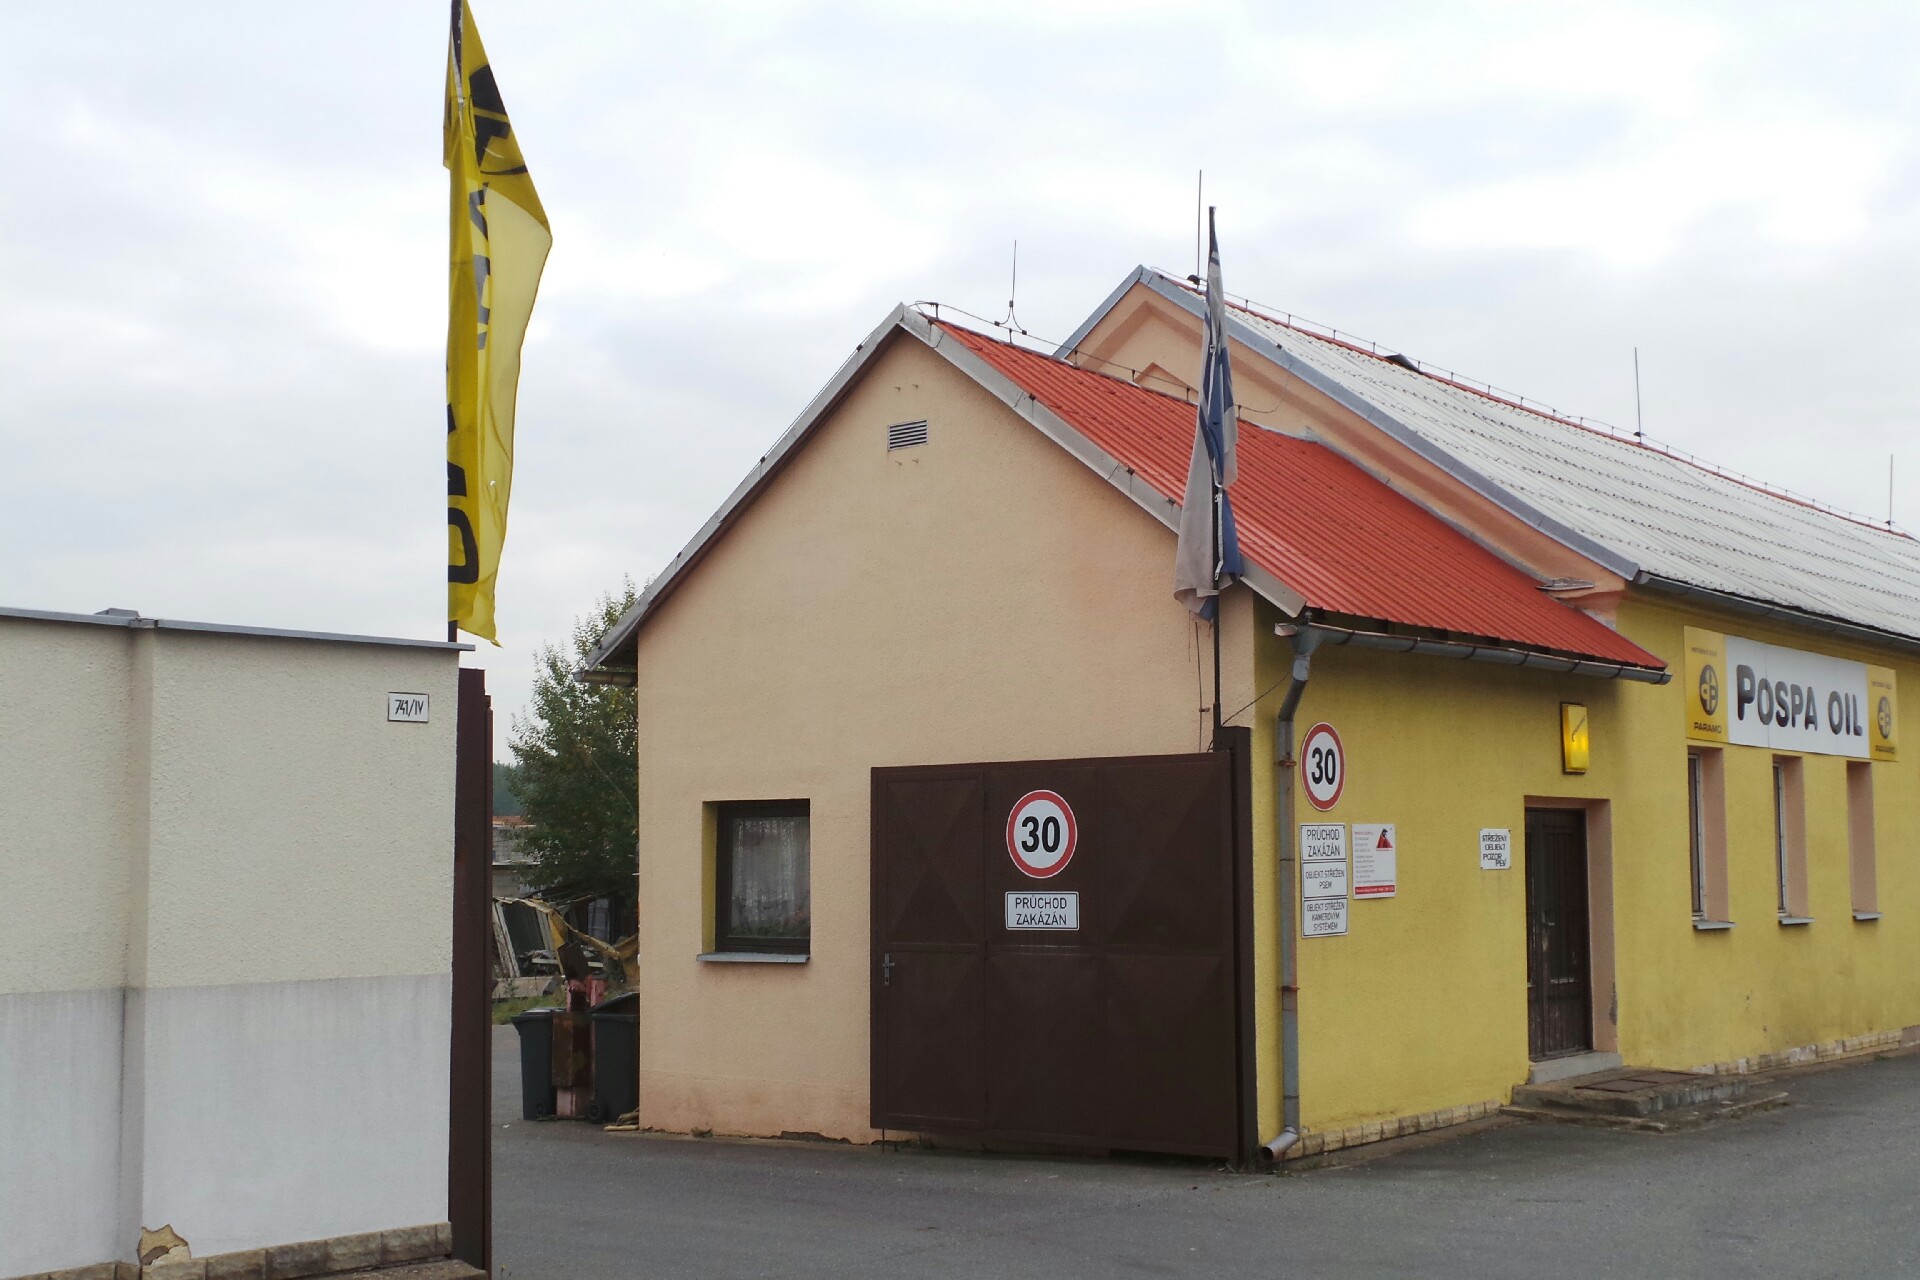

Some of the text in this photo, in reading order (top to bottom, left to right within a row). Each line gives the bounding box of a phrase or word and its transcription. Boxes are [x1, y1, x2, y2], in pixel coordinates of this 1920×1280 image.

[1737, 664, 1863, 737] POSPA OIL
[394, 699, 425, 717] 741/IV
[1693, 722, 1722, 734] PARAMO
[1311, 746, 1337, 786] 30
[1021, 815, 1061, 853] 30
[1307, 827, 1340, 841] PRŮCHOD
[1308, 842, 1341, 857] ZAKÁZÁN
[1305, 870, 1324, 879] OBJEKT
[1324, 868, 1345, 878] STŘEŽEN
[1319, 881, 1332, 889] PSEM
[1015, 895, 1067, 909] PRŮCHOD
[1306, 901, 1345, 912] OBJEKT STŘEŽEN
[1016, 911, 1067, 926] ZAKÁZÁN
